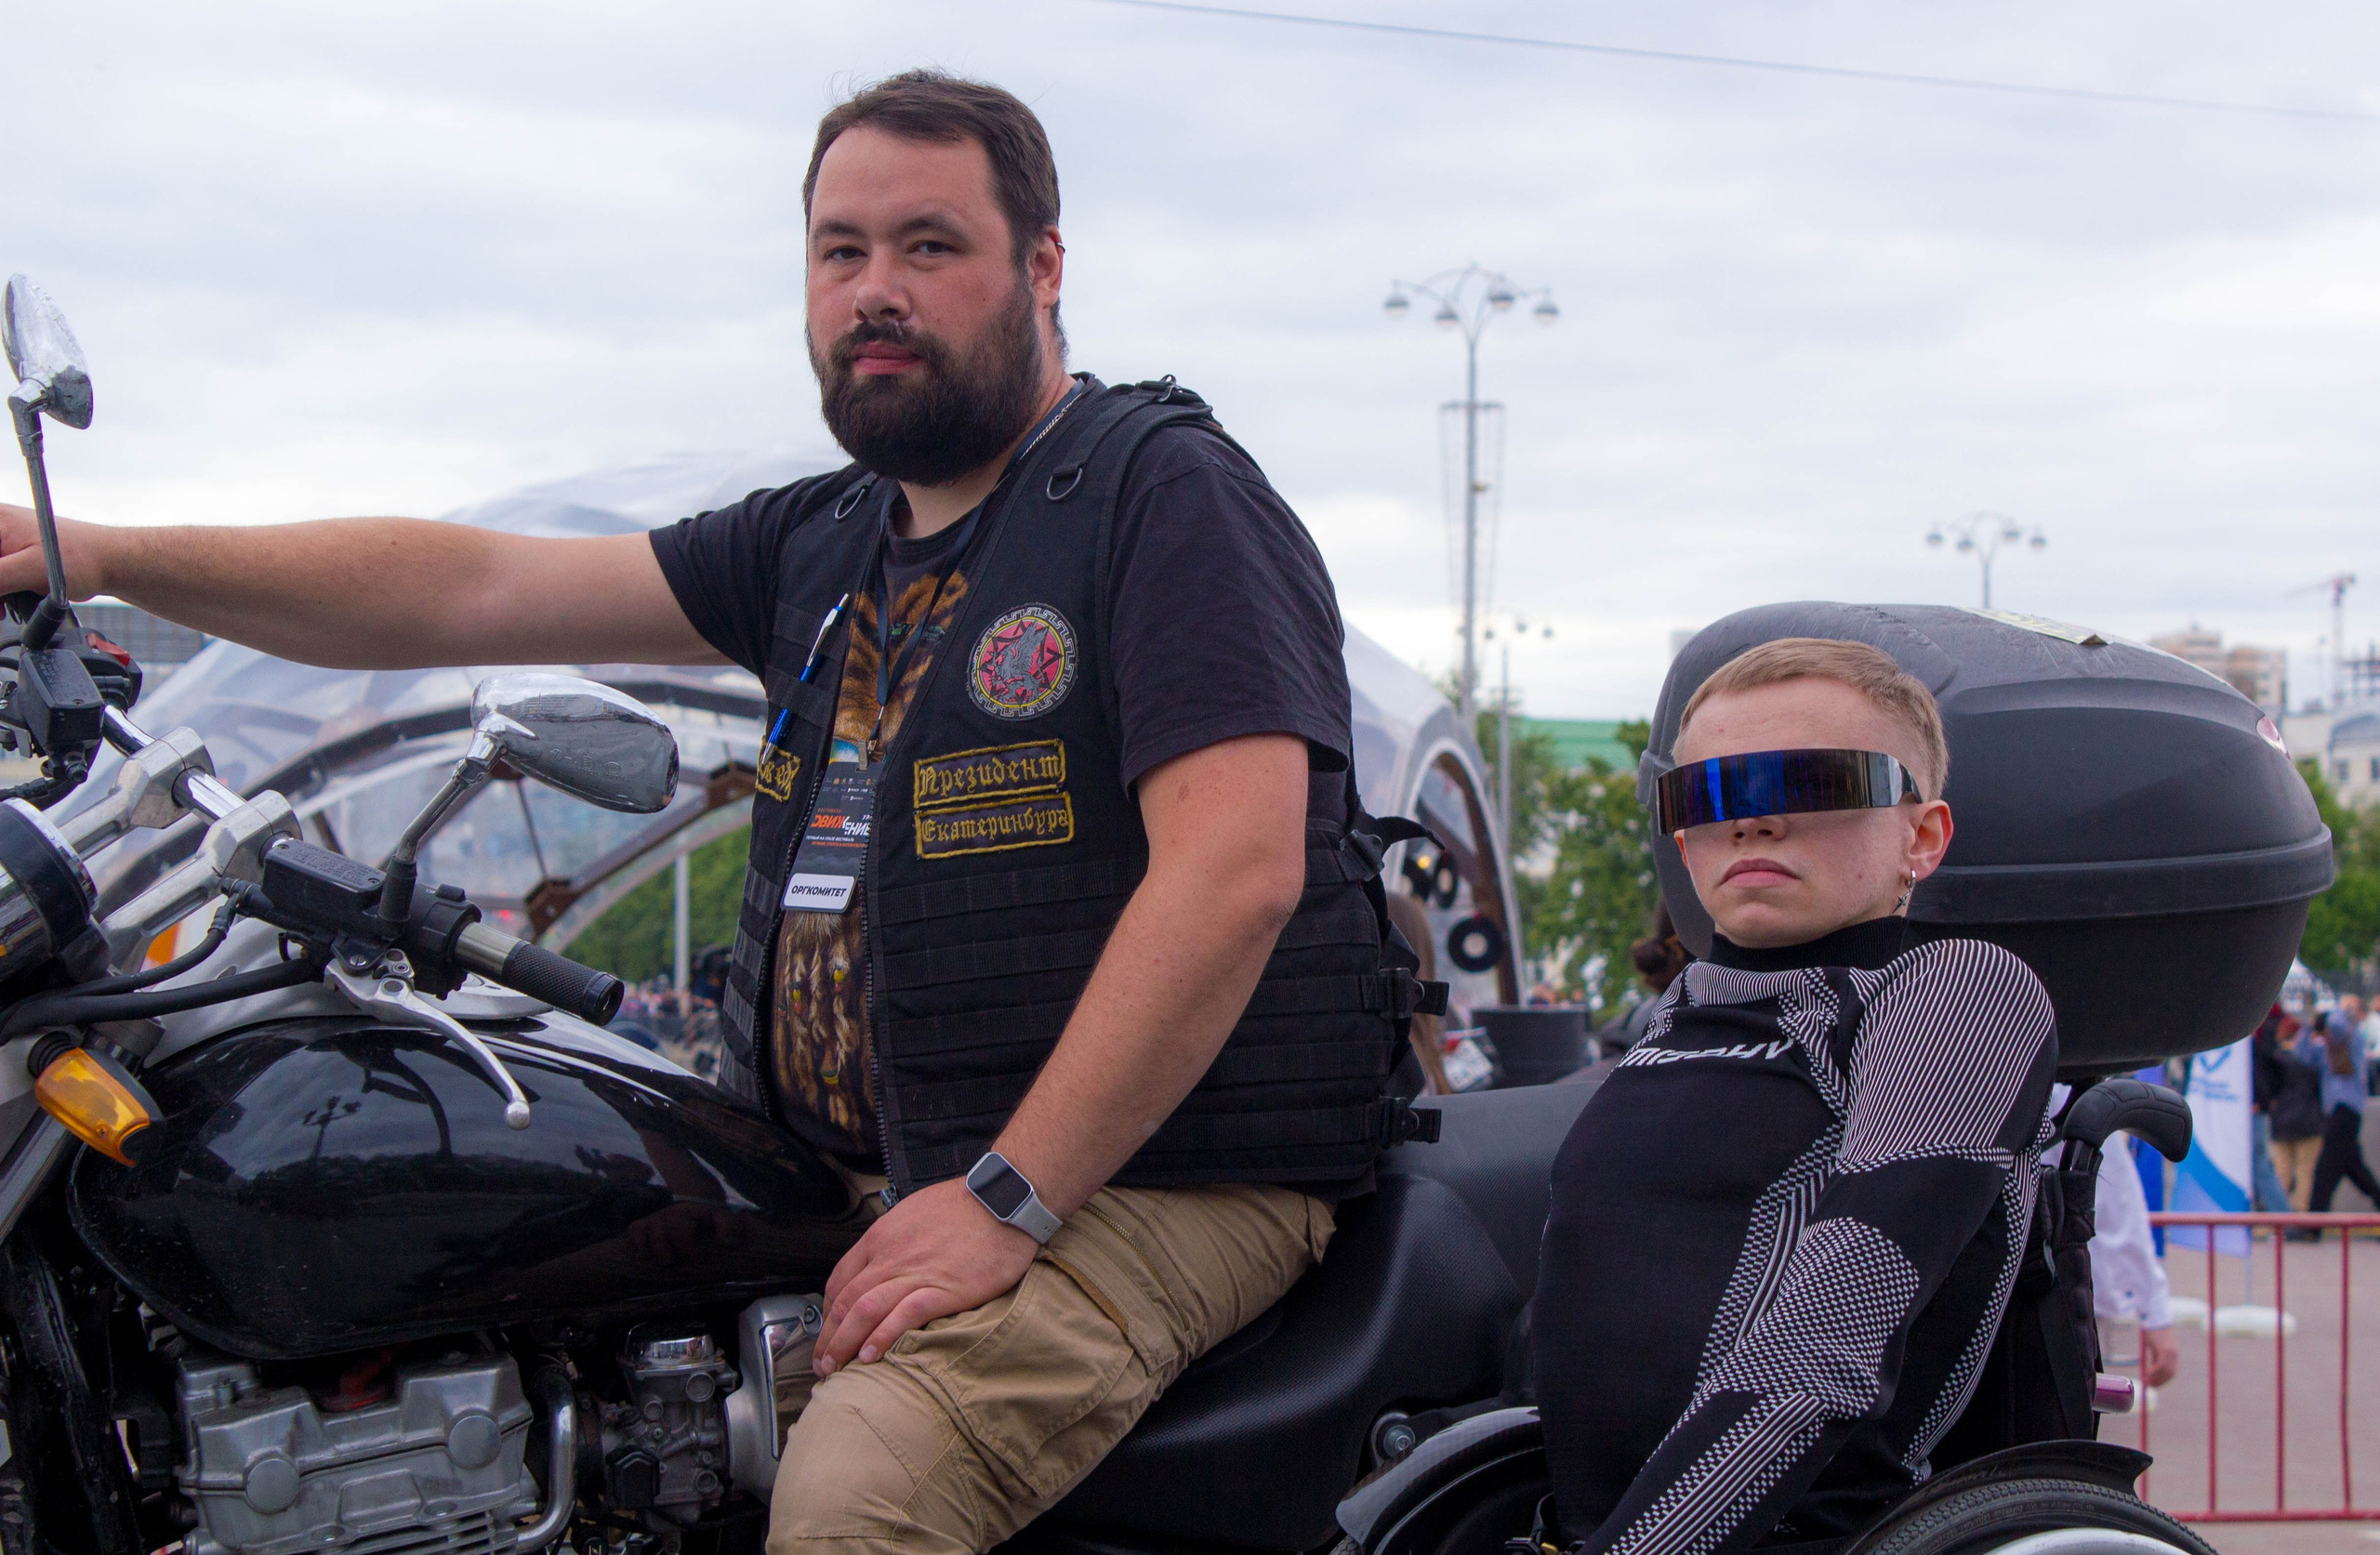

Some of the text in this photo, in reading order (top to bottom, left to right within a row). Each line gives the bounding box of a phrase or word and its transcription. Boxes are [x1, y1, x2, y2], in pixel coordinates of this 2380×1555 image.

[919, 754, 1062, 797] Президент
[921, 807, 1069, 843] Екатеринбург
[791, 885, 847, 898] ОРГКОМИТЕТ
